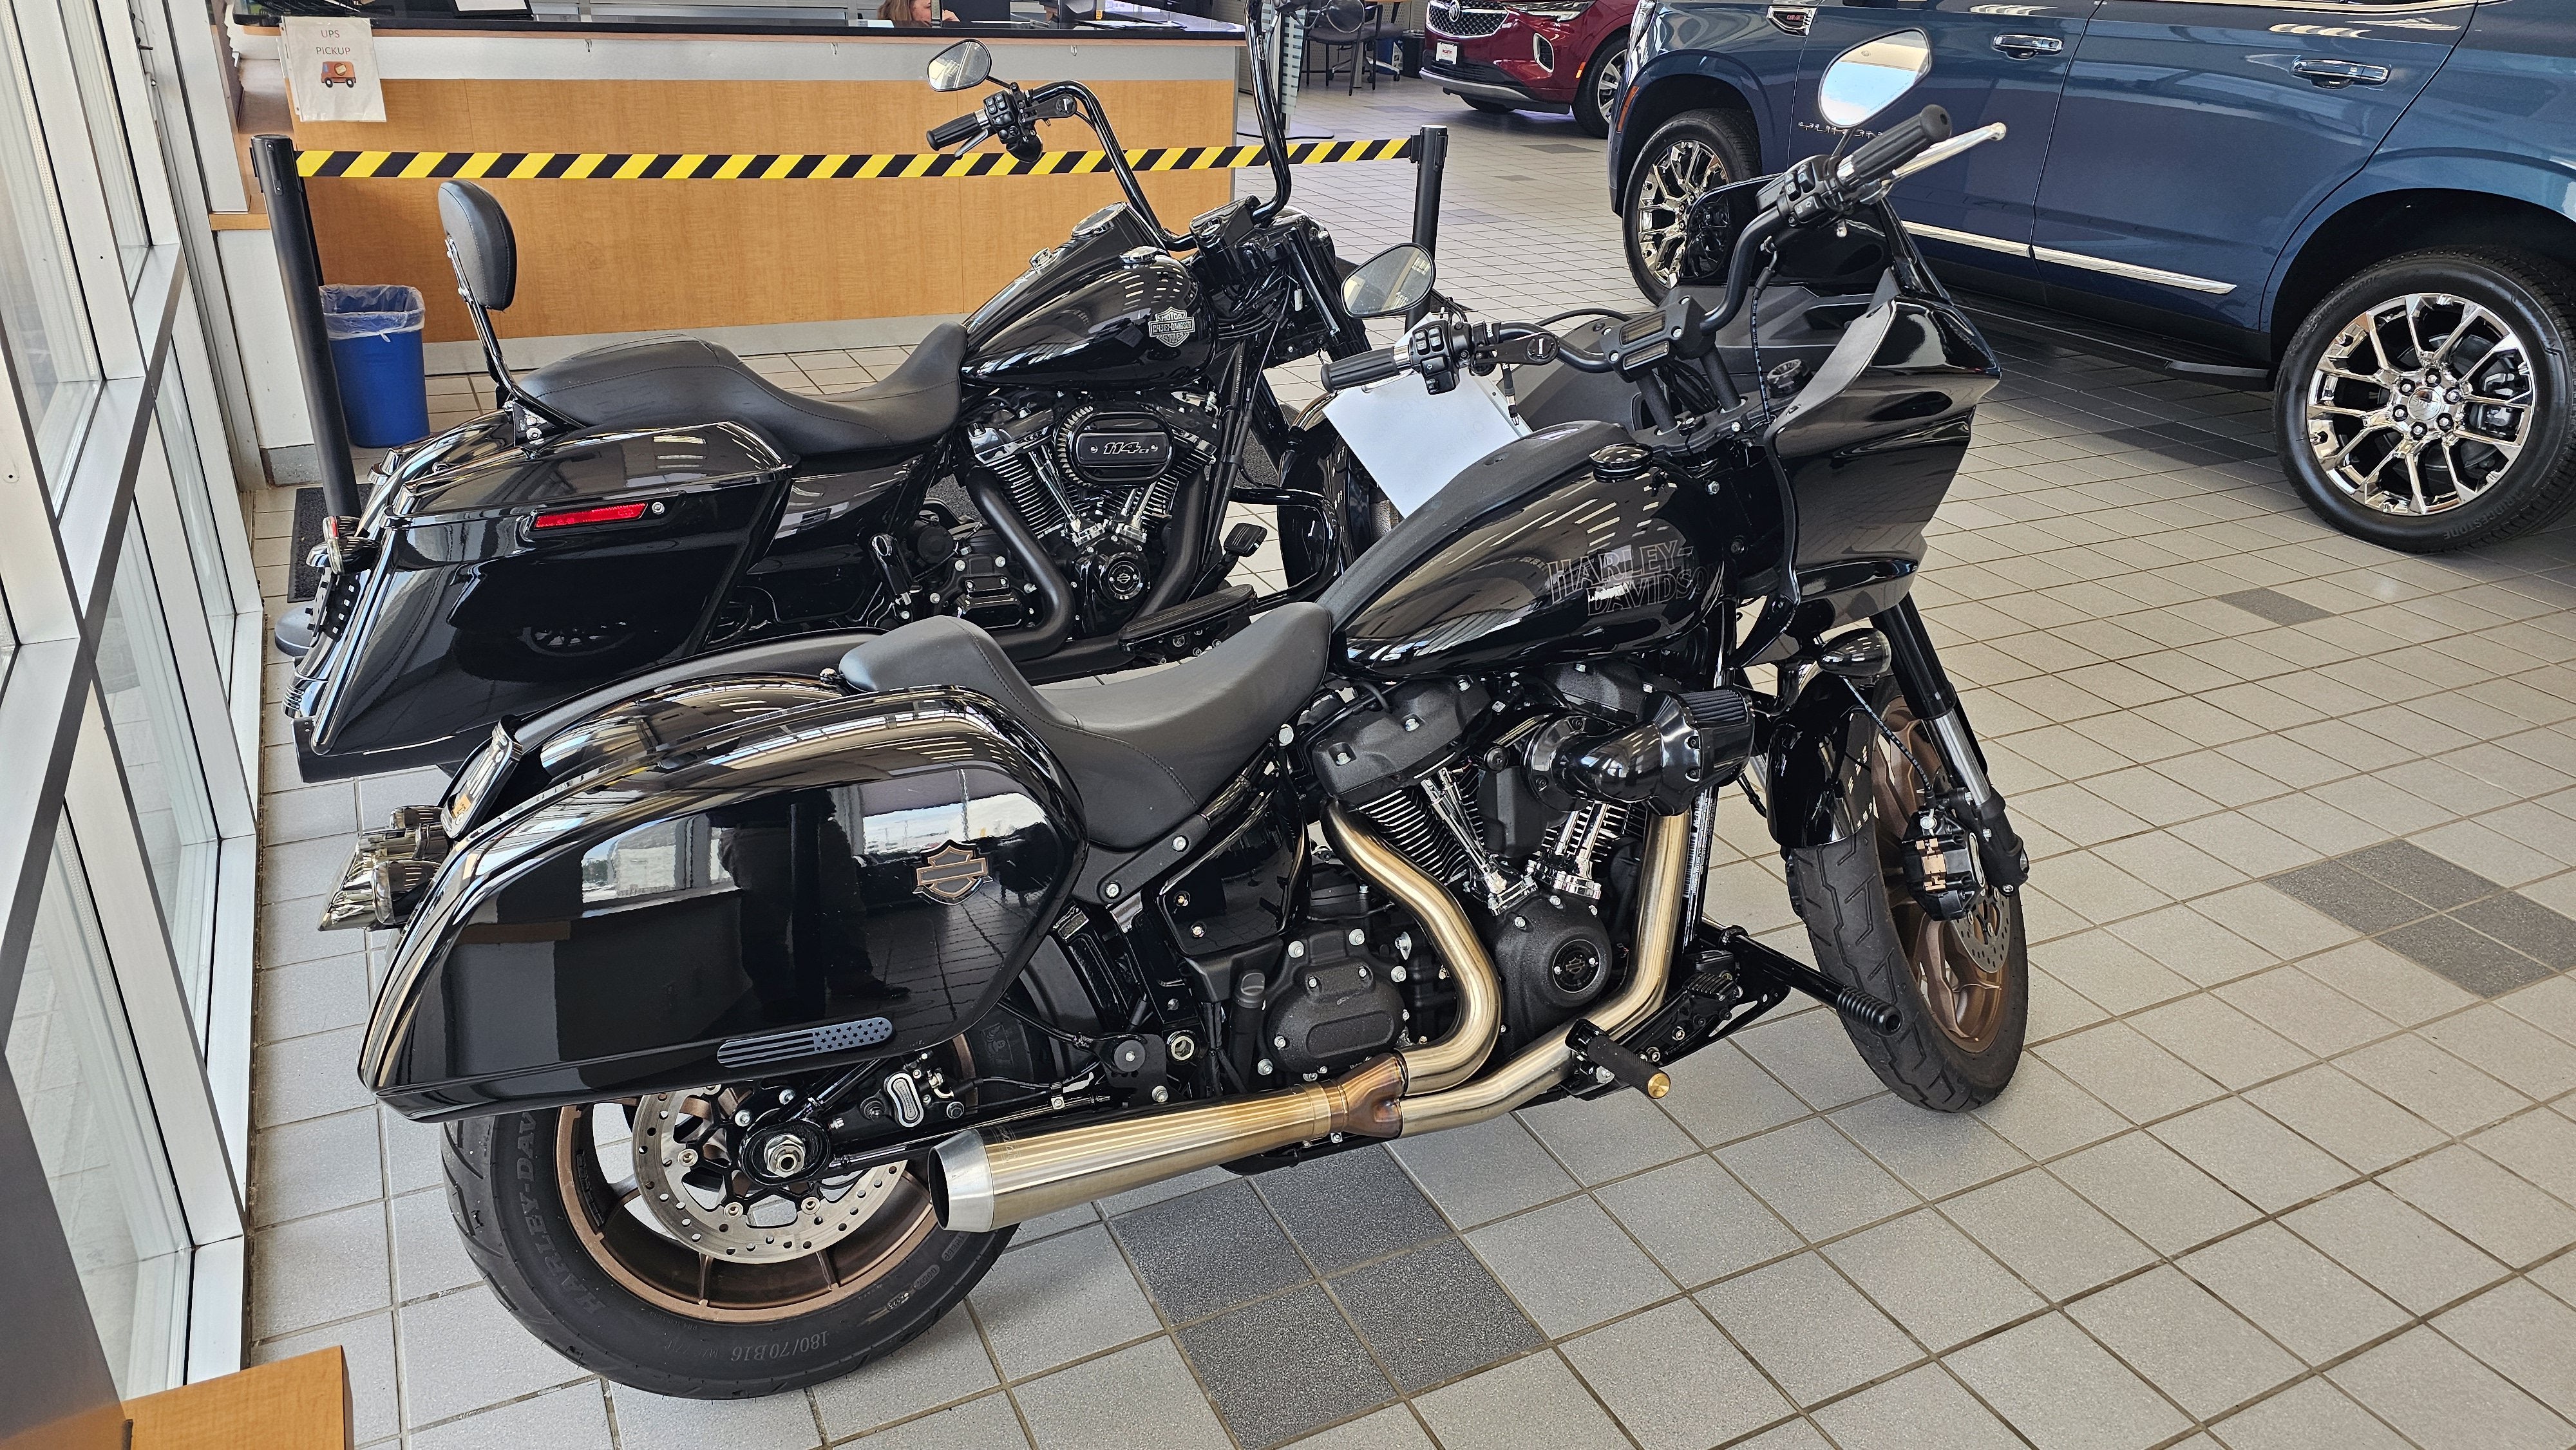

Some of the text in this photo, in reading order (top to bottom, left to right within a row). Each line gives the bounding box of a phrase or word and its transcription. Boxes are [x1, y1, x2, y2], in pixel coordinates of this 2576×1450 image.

[320, 30, 340, 38] UPS
[316, 46, 350, 55] PICKUP
[1161, 312, 1183, 321] MOTOR
[1152, 321, 1192, 333] HARLEY-DAVIDSON
[1546, 540, 1694, 605] HARLEY-
